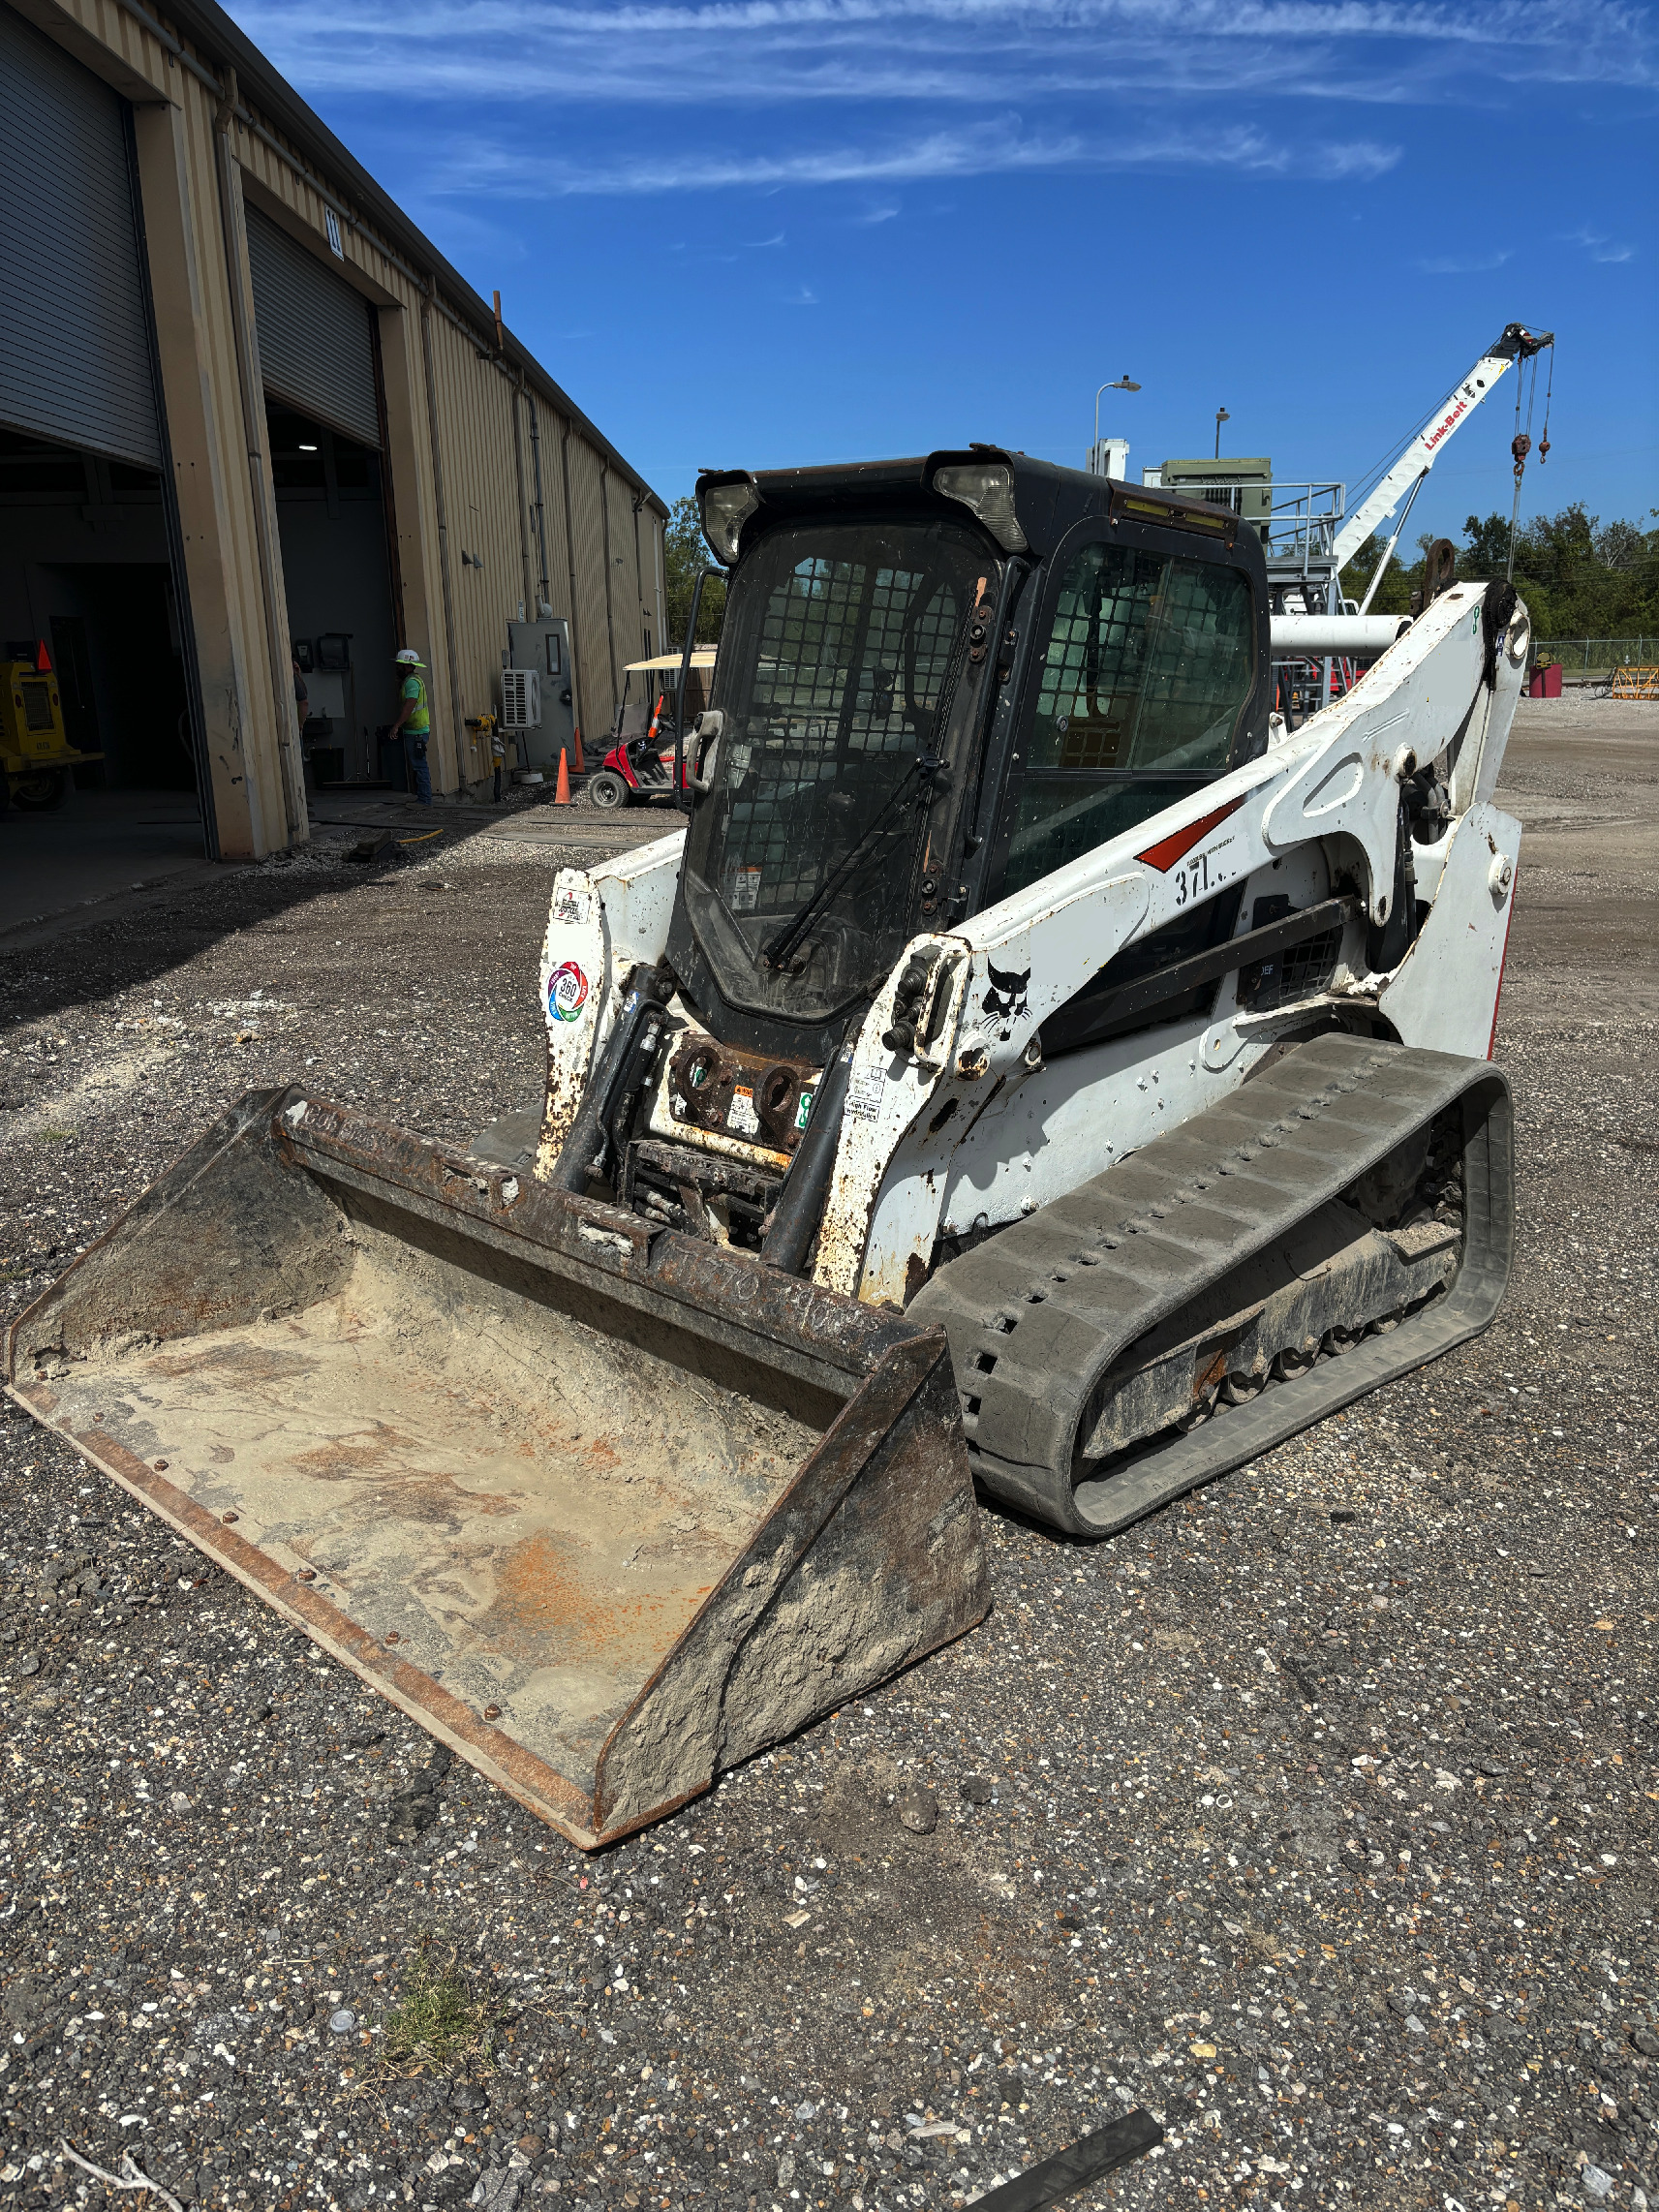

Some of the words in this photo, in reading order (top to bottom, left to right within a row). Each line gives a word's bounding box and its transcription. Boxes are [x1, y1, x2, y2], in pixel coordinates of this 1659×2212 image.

[326, 209, 342, 253] 11
[1425, 401, 1467, 450] Link-Belt
[560, 977, 577, 998] 360
[863, 1104, 877, 1113] Flow
